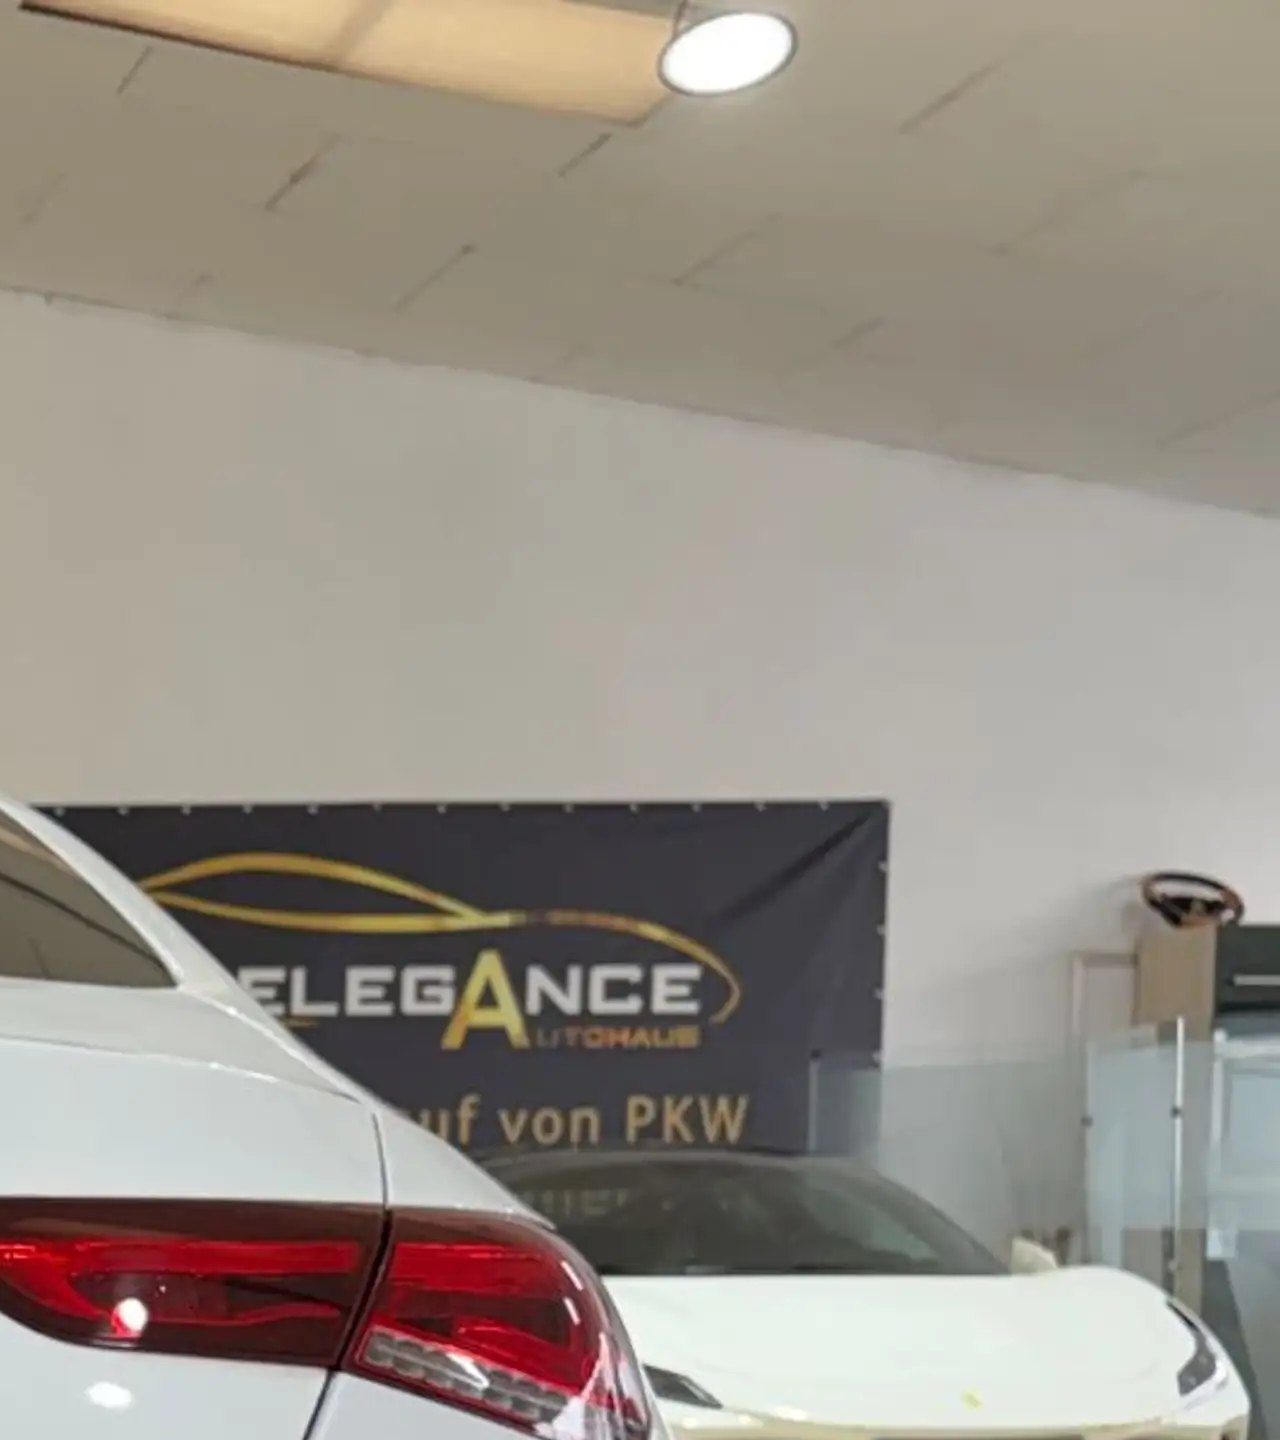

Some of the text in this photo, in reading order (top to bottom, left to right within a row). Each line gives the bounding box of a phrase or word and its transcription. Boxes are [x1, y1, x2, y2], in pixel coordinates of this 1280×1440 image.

[238, 948, 702, 1050] ELEGANCE
[498, 1106, 601, 1145] von
[625, 1094, 749, 1145] PKW
